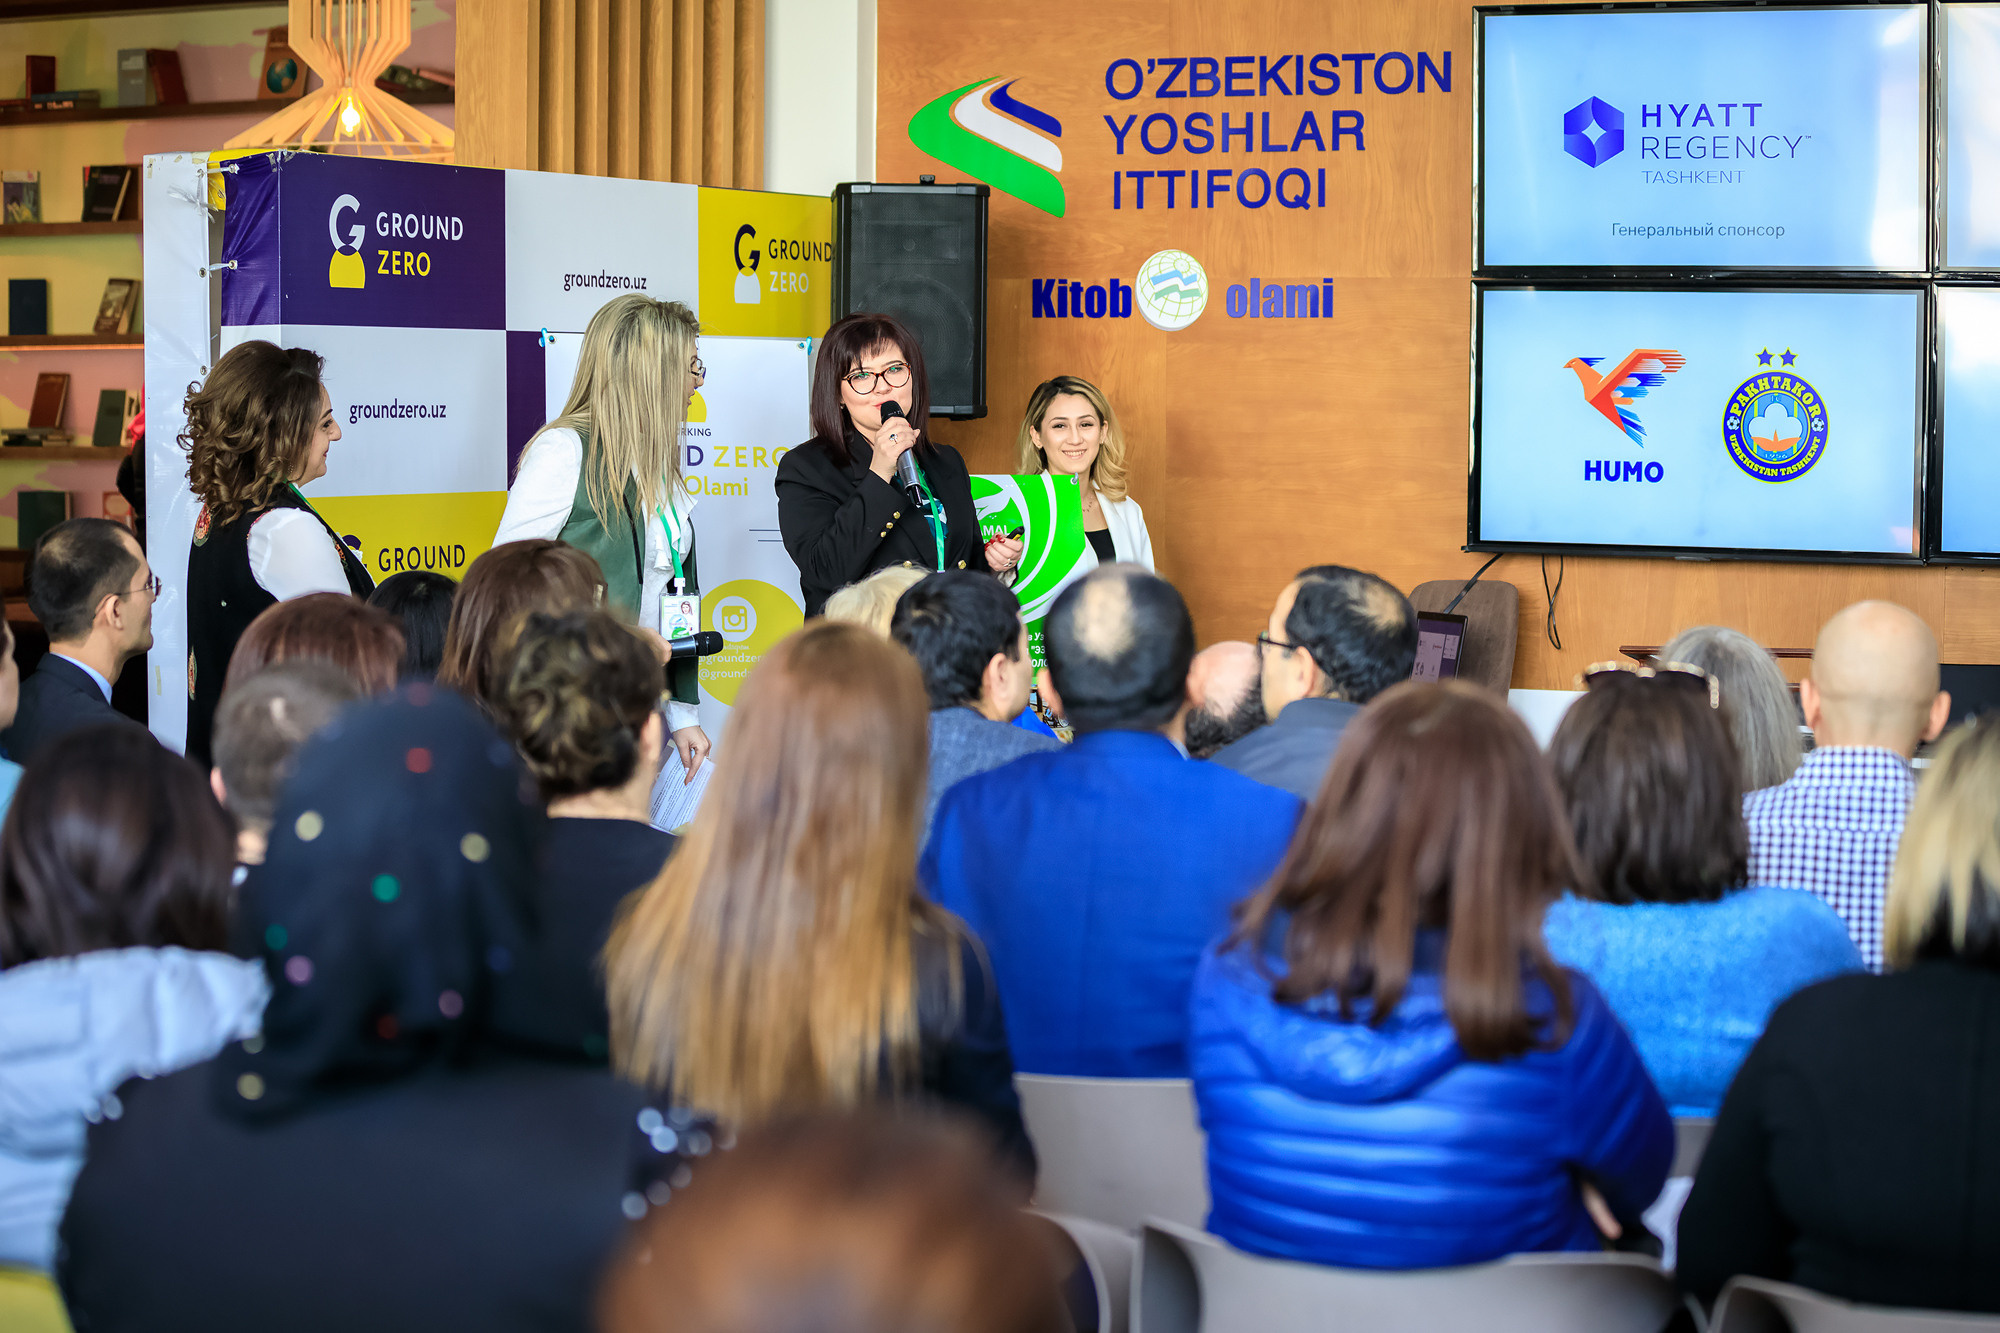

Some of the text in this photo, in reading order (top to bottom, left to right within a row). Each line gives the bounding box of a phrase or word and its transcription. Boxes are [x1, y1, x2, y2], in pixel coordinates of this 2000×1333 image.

[1641, 103, 1763, 128] HYATT
[1103, 110, 1366, 155] YOSHLAR
[1113, 167, 1326, 211] ITTIFOQI
[1641, 170, 1746, 184] TASHKENT
[376, 211, 464, 241] GROUND
[1612, 222, 1786, 240] Генеральный спонсор
[377, 249, 431, 277] ZERO
[768, 238, 833, 263] GROUND
[563, 270, 647, 291] groundzero.uz
[769, 271, 810, 294] ZERO
[1032, 278, 1334, 319] Kitob olami
[1730, 376, 1821, 419] PAKHTAKOR
[349, 398, 447, 424] groundzero.uz
[1729, 434, 1821, 477] UZBEKISTAN TASHKENT
[1584, 459, 1664, 483] HUMO
[684, 475, 748, 496] Olami
[378, 544, 466, 572] GROUND
